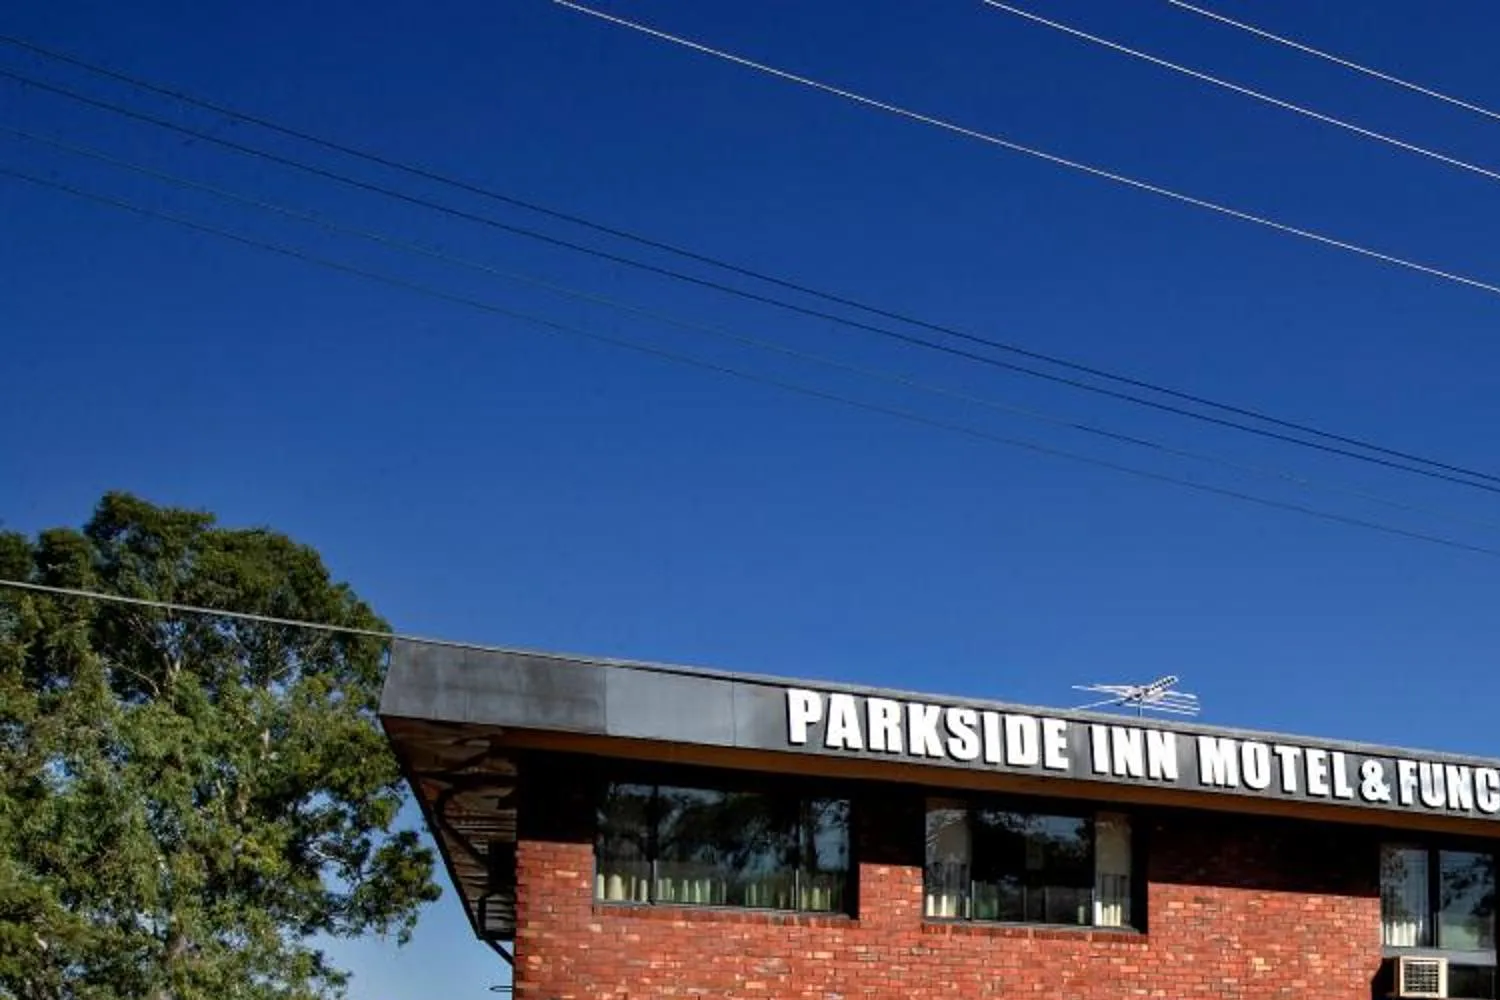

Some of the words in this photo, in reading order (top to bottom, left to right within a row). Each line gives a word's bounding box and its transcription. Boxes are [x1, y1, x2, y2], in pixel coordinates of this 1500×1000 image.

[787, 688, 1069, 770] PARKSIDE
[1089, 723, 1179, 781] INN
[1197, 735, 1353, 799] MOTEL
[1360, 758, 1391, 803] &
